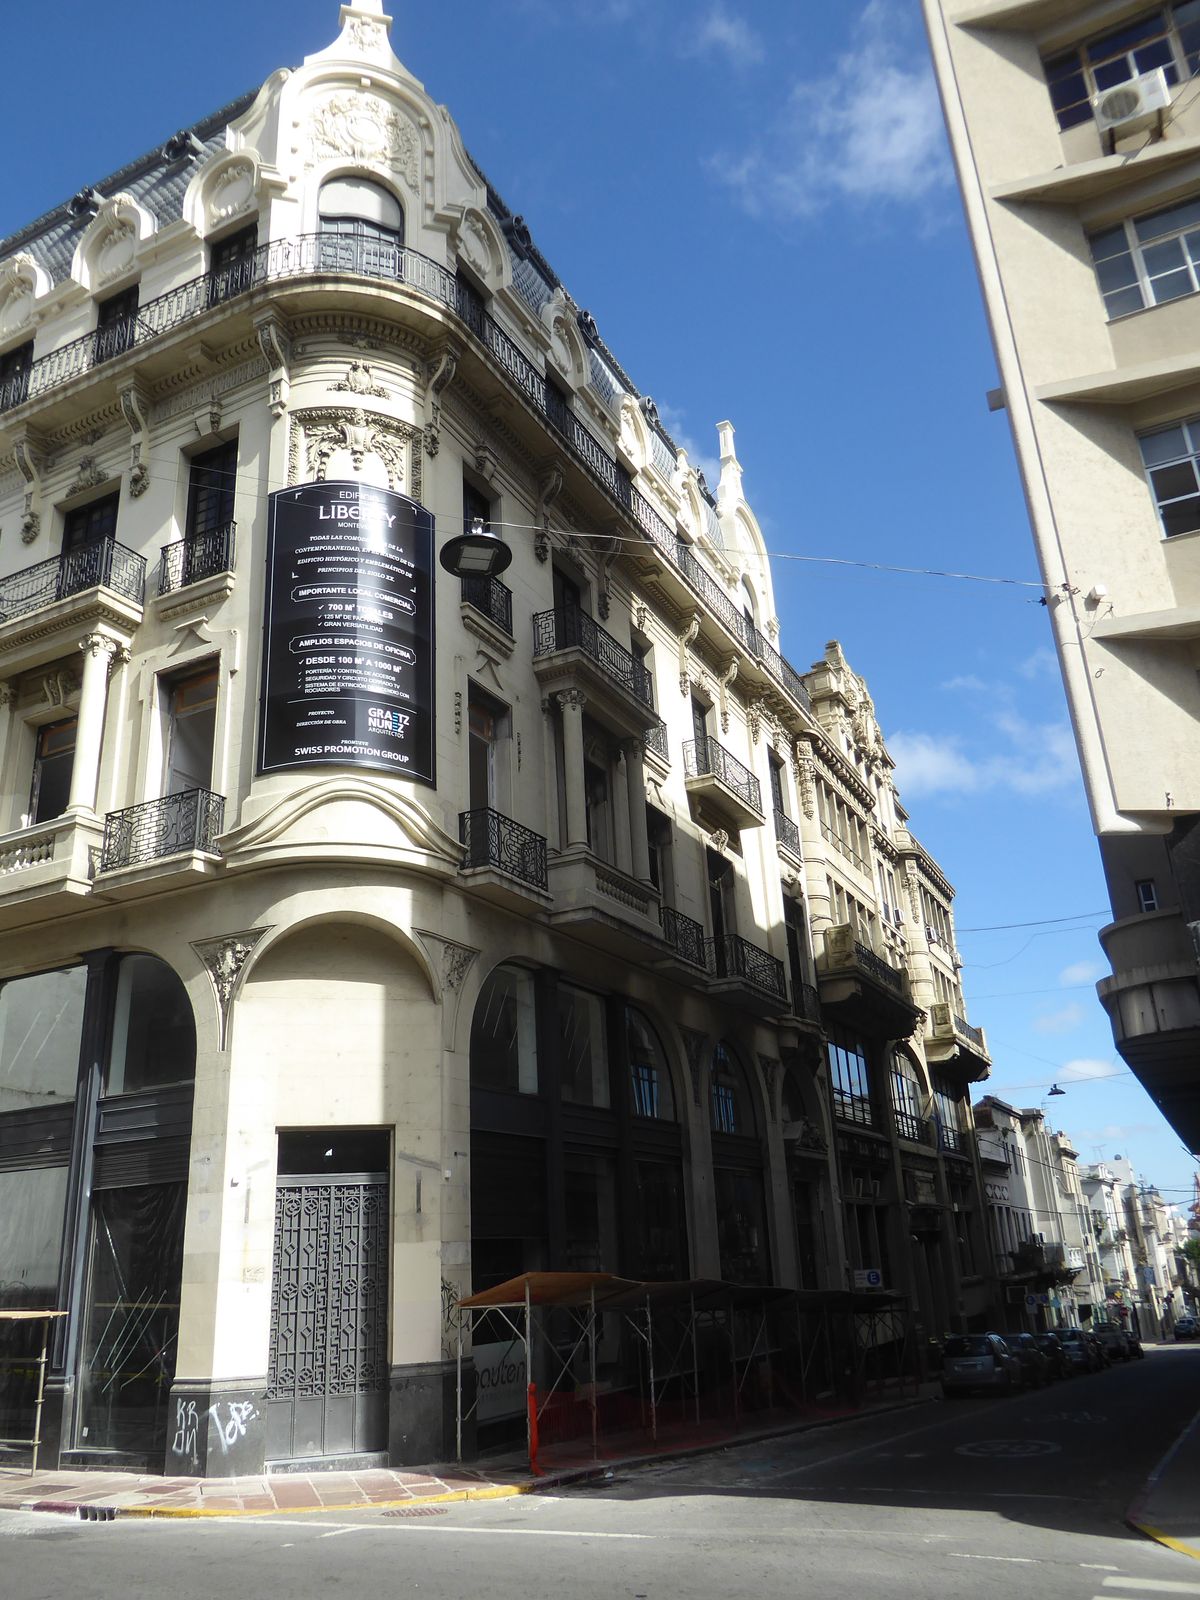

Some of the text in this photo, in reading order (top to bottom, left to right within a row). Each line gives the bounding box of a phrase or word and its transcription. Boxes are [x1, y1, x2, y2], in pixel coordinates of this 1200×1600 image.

[319, 505, 396, 528] LIBEY
[343, 535, 387, 549] COMODS
[297, 556, 324, 565] EDIFICIO
[324, 555, 359, 563] HISTÓRICO
[365, 558, 405, 576] EMBLEMÁTICO
[367, 570, 386, 579] SIGLO
[298, 586, 413, 611] IMPORTANTE LOCAL COMERCIAL
[328, 603, 343, 611] 700
[342, 622, 384, 633] VERSATILIDAD
[299, 637, 411, 660] AMPLIOS ESPACIOS DE OFICINA
[306, 656, 336, 665] DESDE
[338, 656, 353, 664] 100
[374, 660, 392, 670] 1000
[305, 667, 332, 675] PORTERÍA
[337, 668, 364, 677] CONTROL
[371, 672, 396, 682] ACCESOS
[337, 681, 367, 689] EXTINCIÓN
[368, 727, 405, 740] ARQUITECTOS
[295, 745, 410, 764] SWISS PROMOTION GROUP
